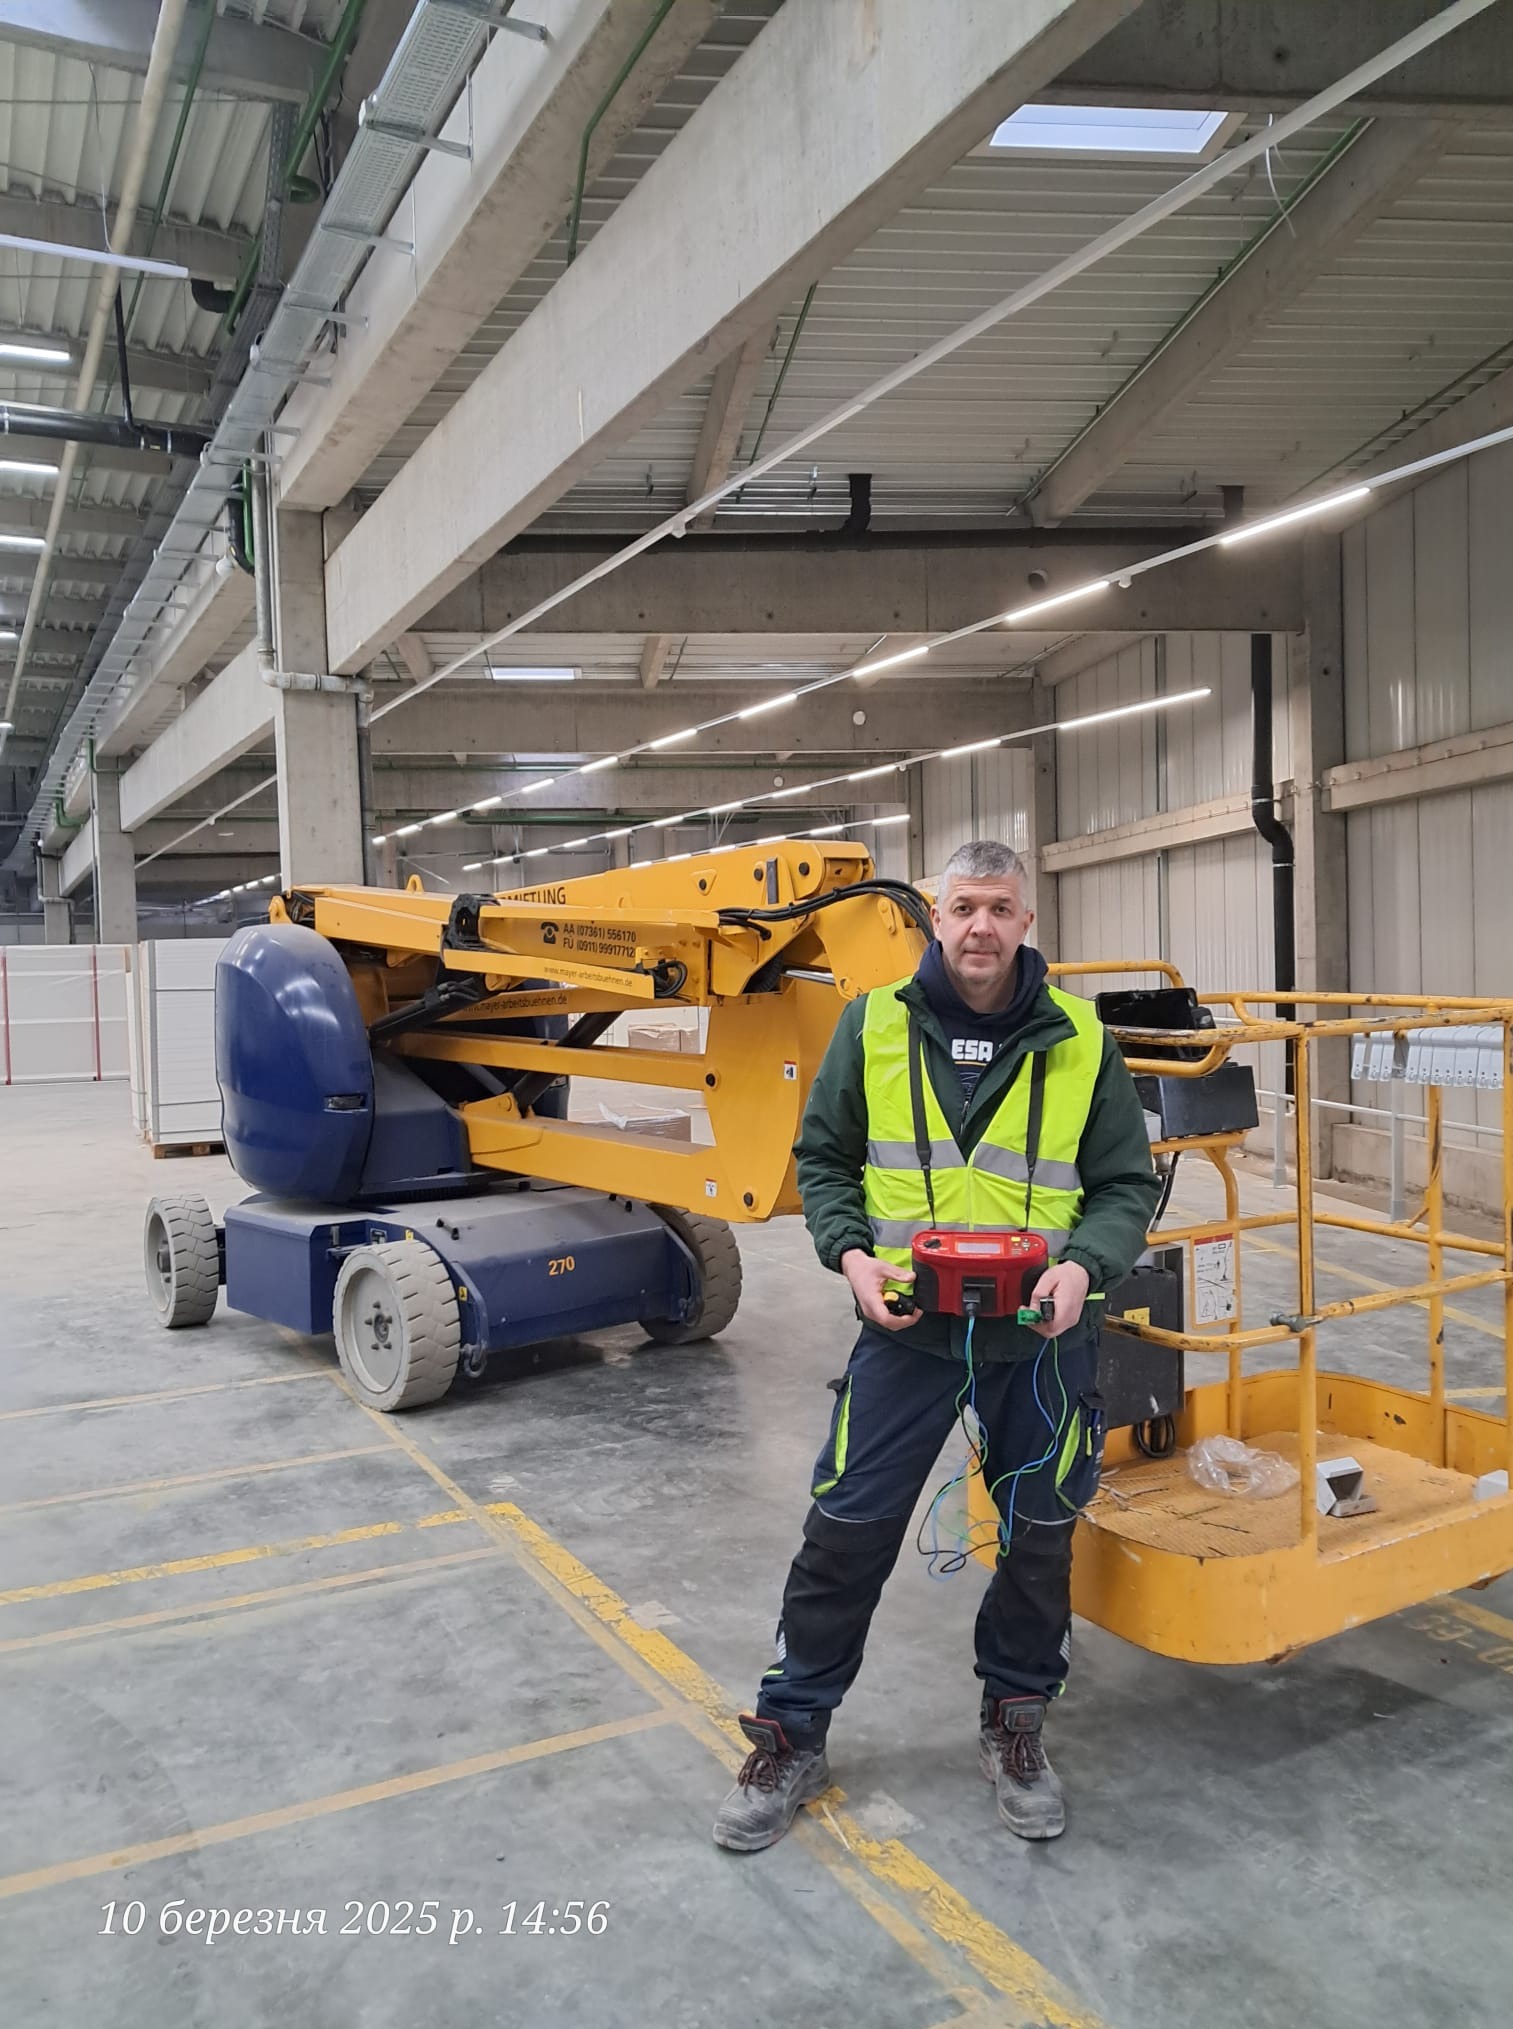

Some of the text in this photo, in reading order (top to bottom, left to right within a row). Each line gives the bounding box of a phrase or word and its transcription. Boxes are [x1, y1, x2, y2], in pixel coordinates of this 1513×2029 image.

[563, 923, 575, 935] AA
[607, 928, 636, 943] 556170
[548, 1255, 575, 1276] 270
